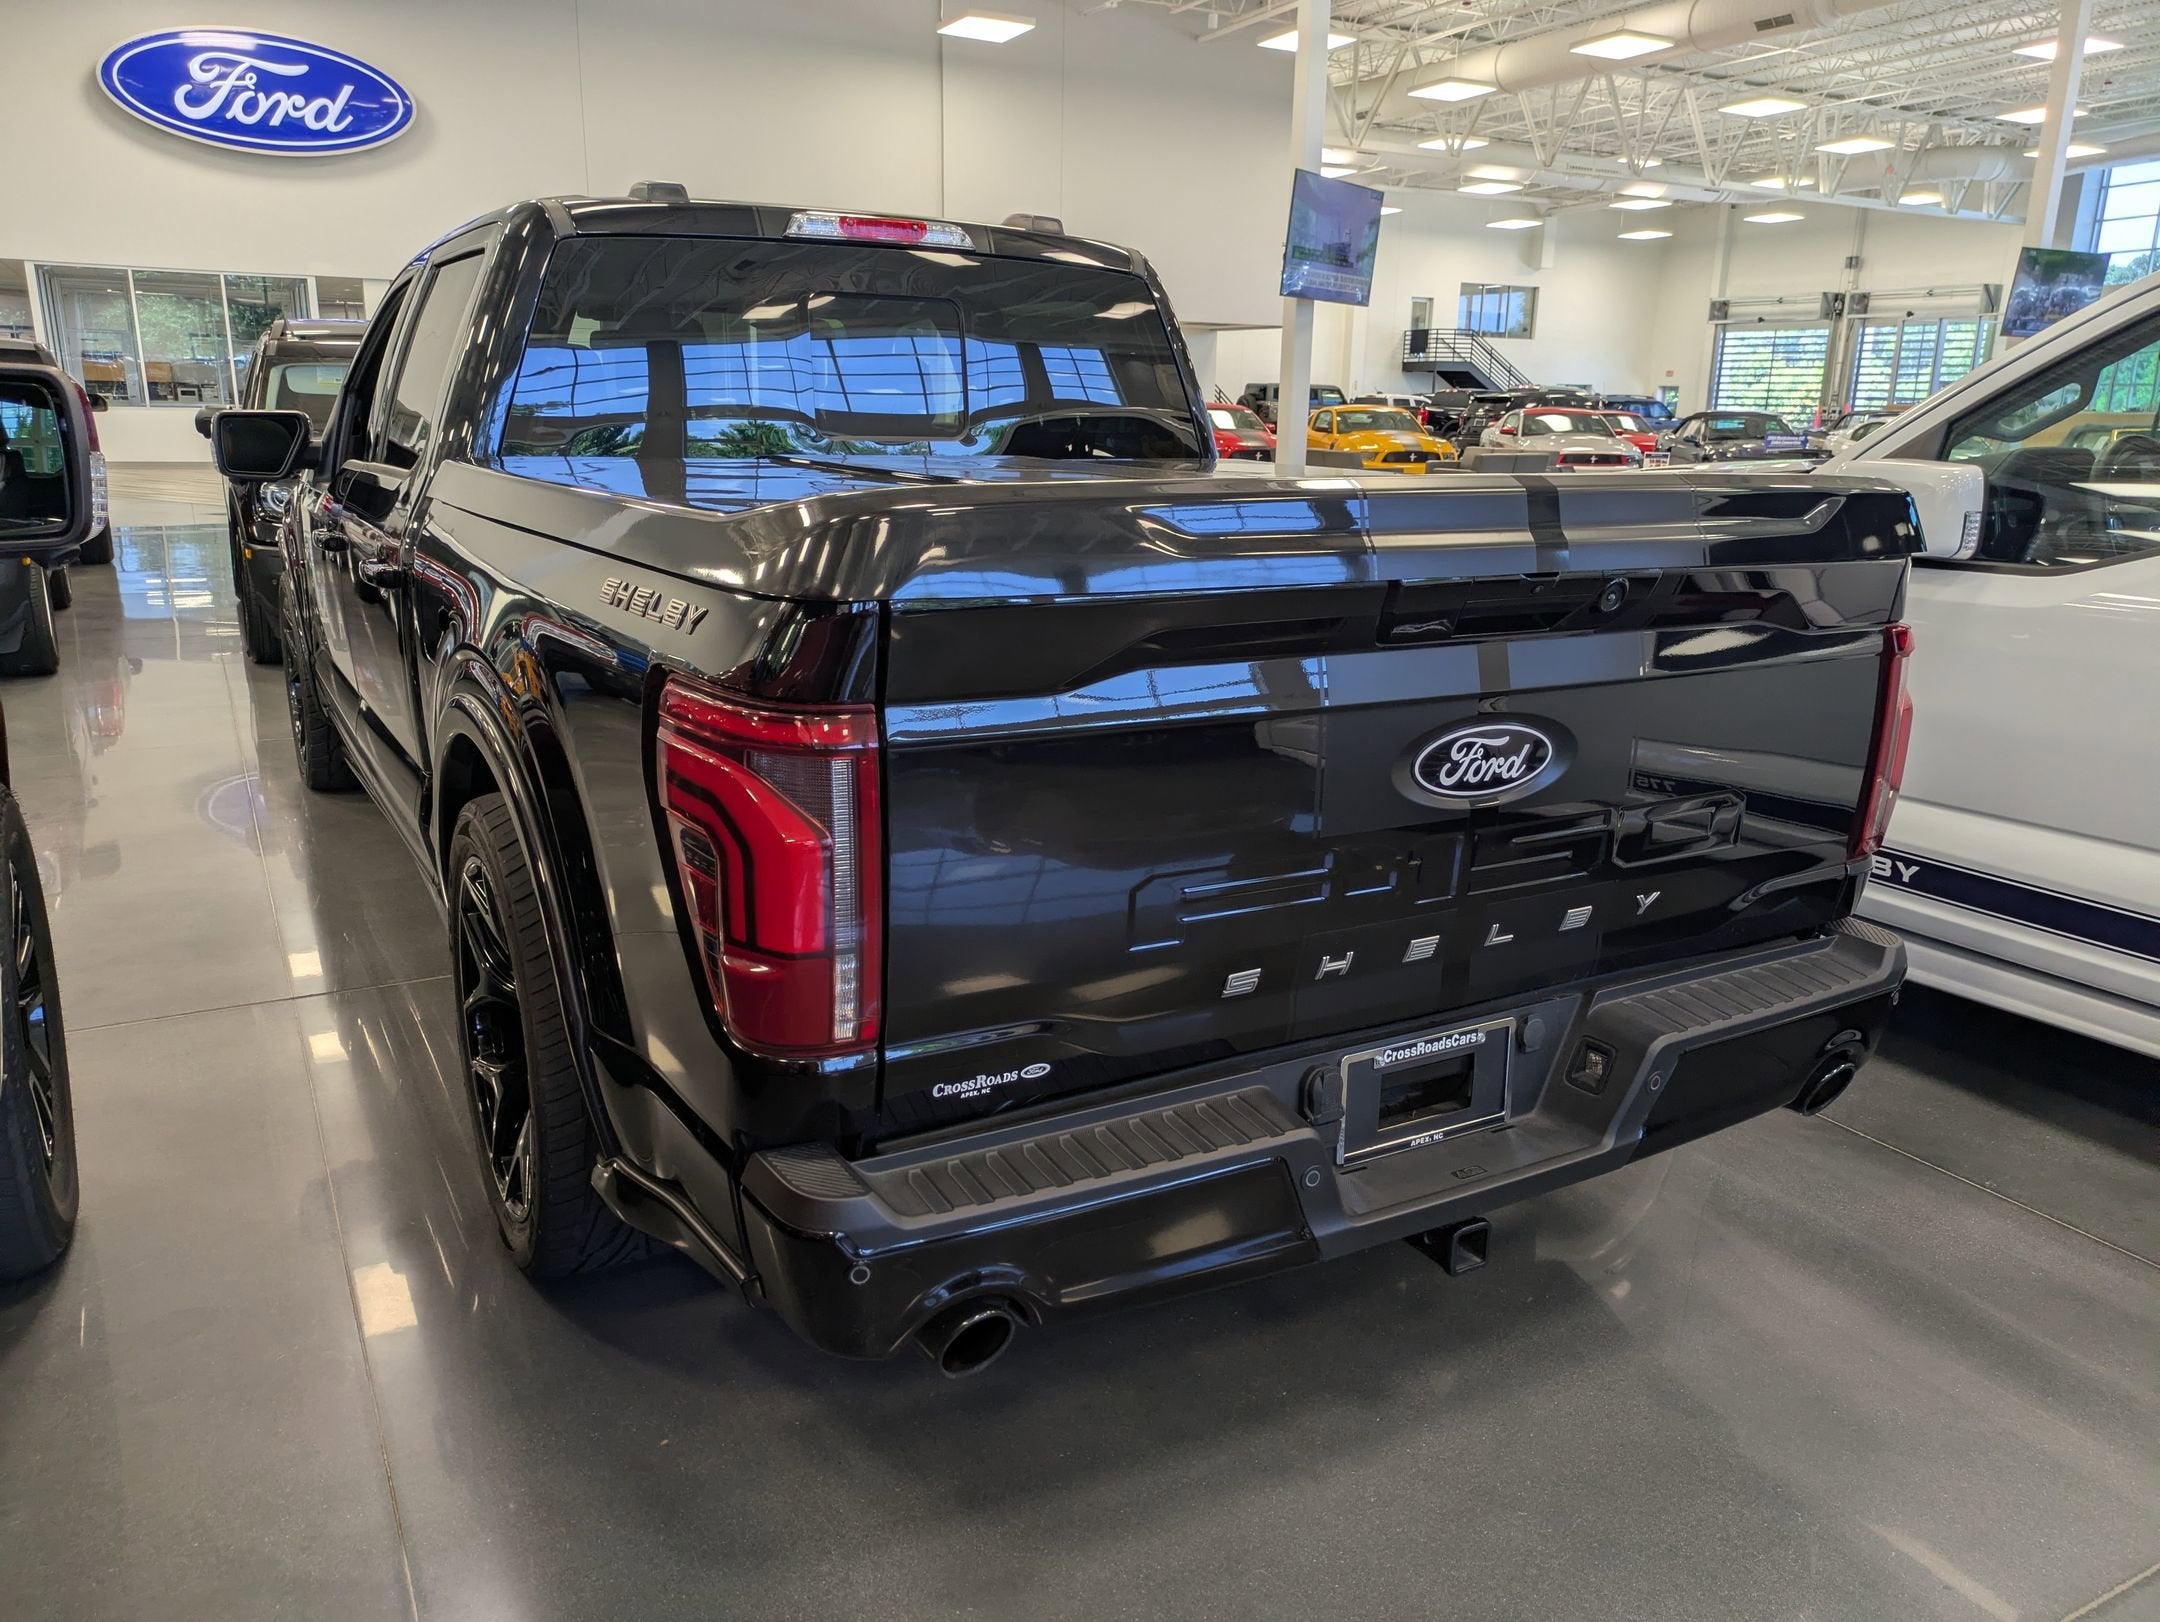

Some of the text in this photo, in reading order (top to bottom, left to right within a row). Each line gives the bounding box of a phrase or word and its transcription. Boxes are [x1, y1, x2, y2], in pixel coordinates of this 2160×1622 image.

[174, 51, 355, 133] Ford
[598, 577, 708, 635] SHELBY
[1439, 735, 1531, 786] Ford
[1221, 890, 1661, 998] SHELBY
[981, 1087, 991, 1095] NC
[1433, 1132, 1444, 1140] NC
